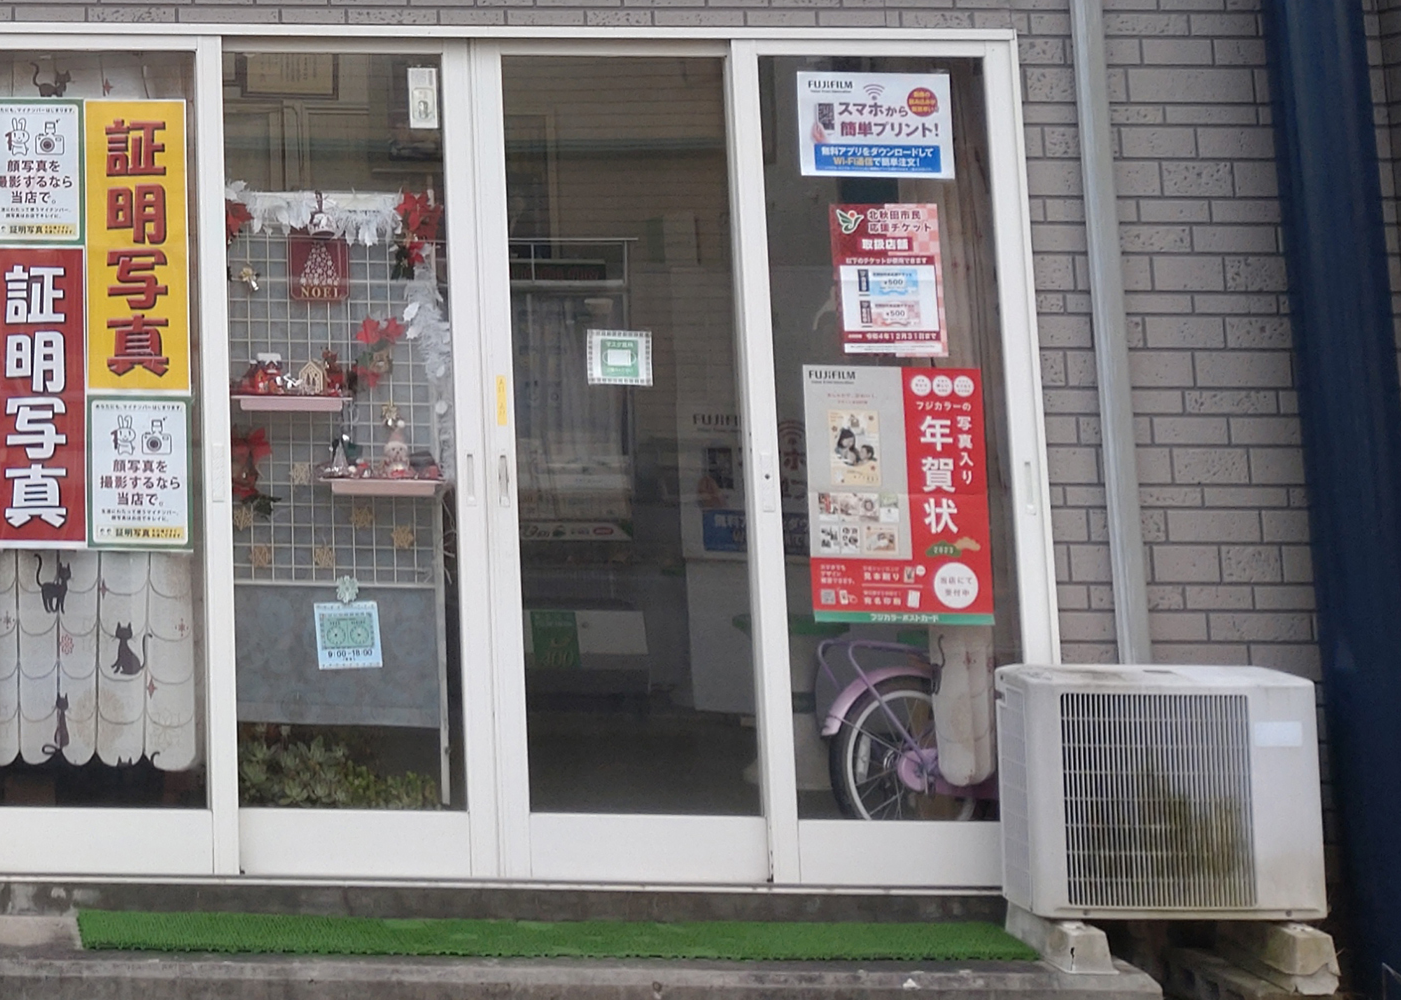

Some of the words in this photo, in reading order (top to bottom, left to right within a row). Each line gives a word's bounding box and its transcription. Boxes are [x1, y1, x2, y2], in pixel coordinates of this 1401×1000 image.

[808, 80, 853, 89] FUJIFILM
[838, 102, 908, 117] スマホから
[7, 160, 61, 172] 顔写真を
[867, 208, 921, 220] 北秋田市民
[869, 222, 932, 234] 応援チケット
[105, 118, 169, 377] 証明写真
[809, 370, 856, 380] FUJIFILM
[5, 265, 68, 529] 証明写真
[916, 401, 972, 411] フジカラーの
[956, 416, 975, 485] 写真入り
[113, 459, 167, 473] 顔写真を
[920, 415, 959, 534] 年賀状
[100, 475, 181, 490] 撮影するなら
[870, 612, 940, 623] フジカラーポストカード
